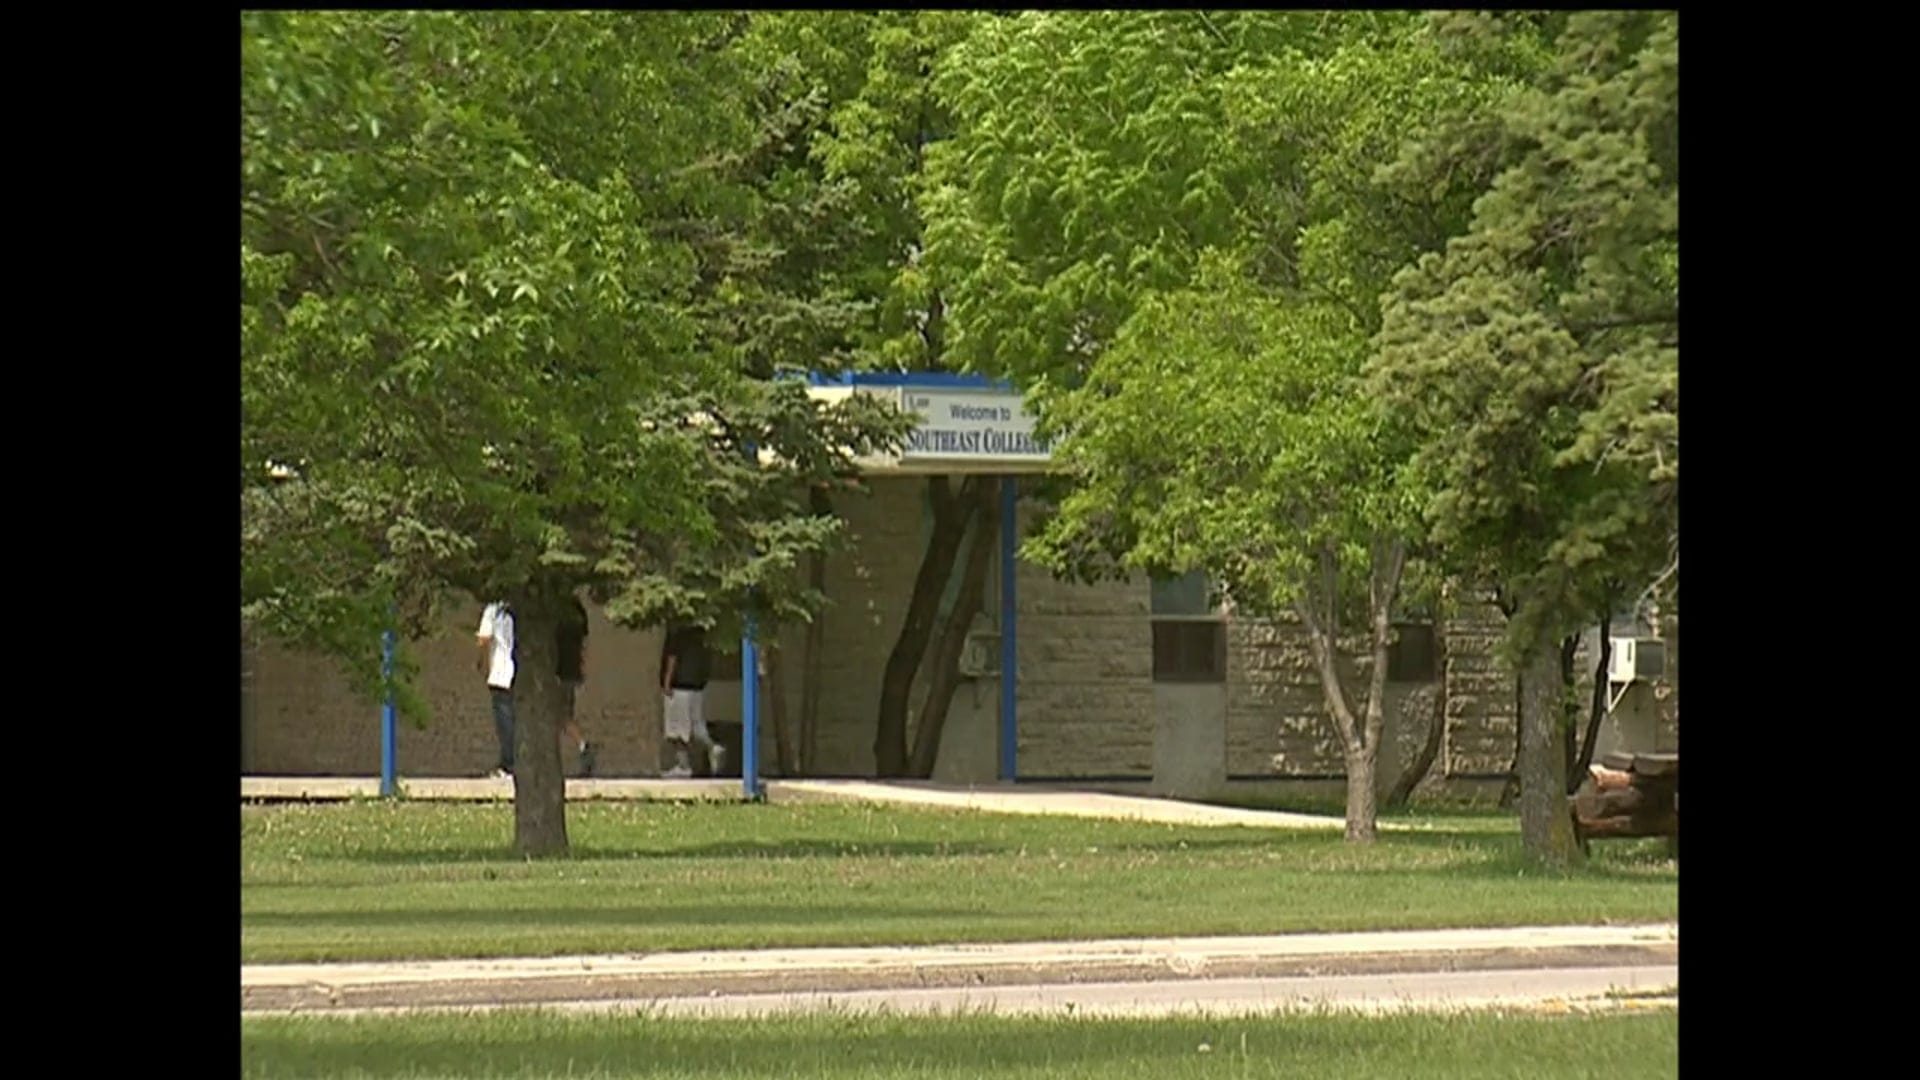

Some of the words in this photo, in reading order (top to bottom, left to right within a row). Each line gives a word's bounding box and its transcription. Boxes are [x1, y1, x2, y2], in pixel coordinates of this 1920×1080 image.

[950, 405, 997, 421] Welcome
[1000, 406, 1011, 421] to
[906, 429, 980, 453] SOUTHEAST
